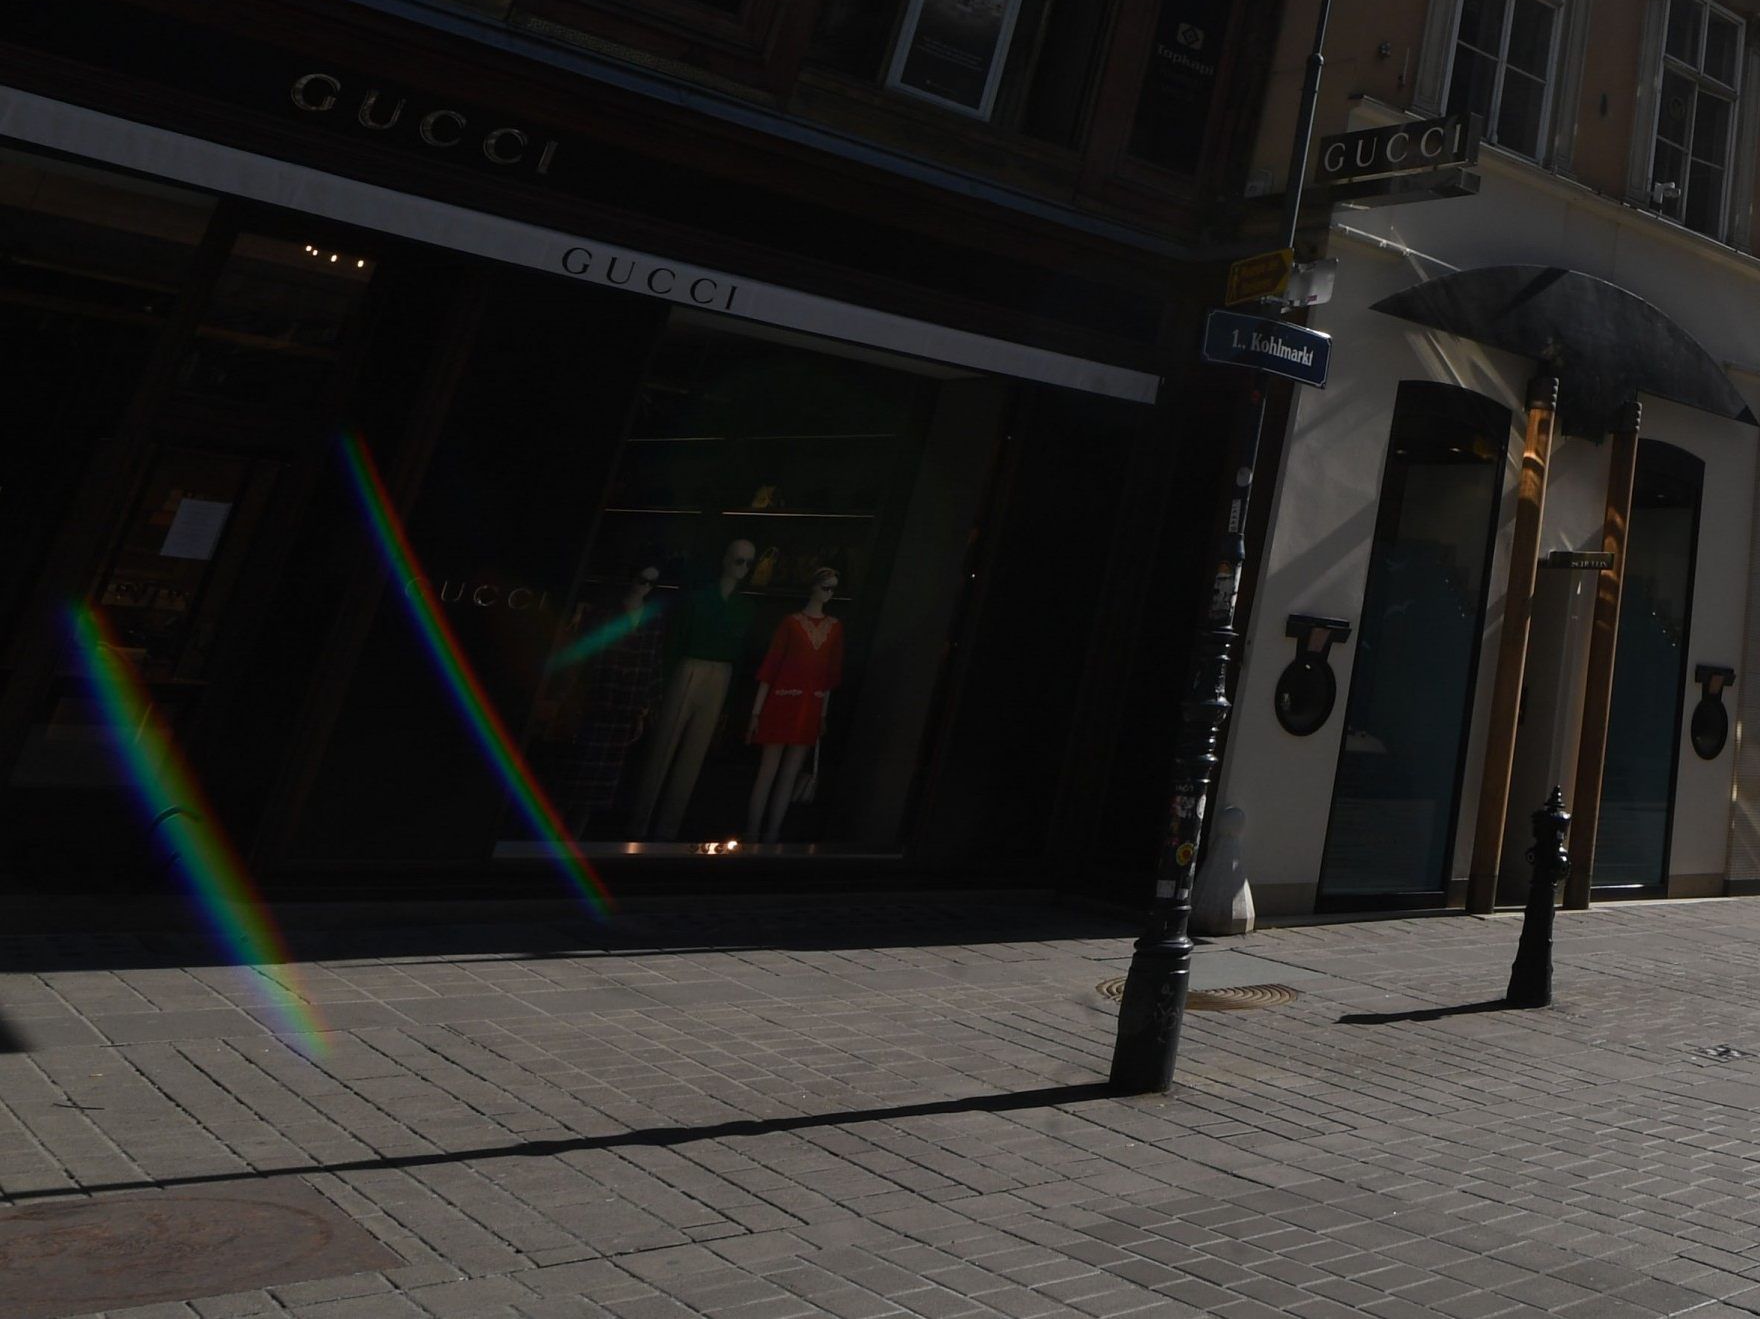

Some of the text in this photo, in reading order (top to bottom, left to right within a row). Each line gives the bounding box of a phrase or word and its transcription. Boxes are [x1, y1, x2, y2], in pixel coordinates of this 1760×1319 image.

[1157, 43, 1215, 76] Topkapi
[290, 72, 560, 174] GUCCI
[1324, 122, 1464, 172] GUCCI
[562, 246, 737, 310] GUCCI
[1250, 331, 1314, 367] Kohlmarkt
[405, 577, 548, 610] GUCCI
